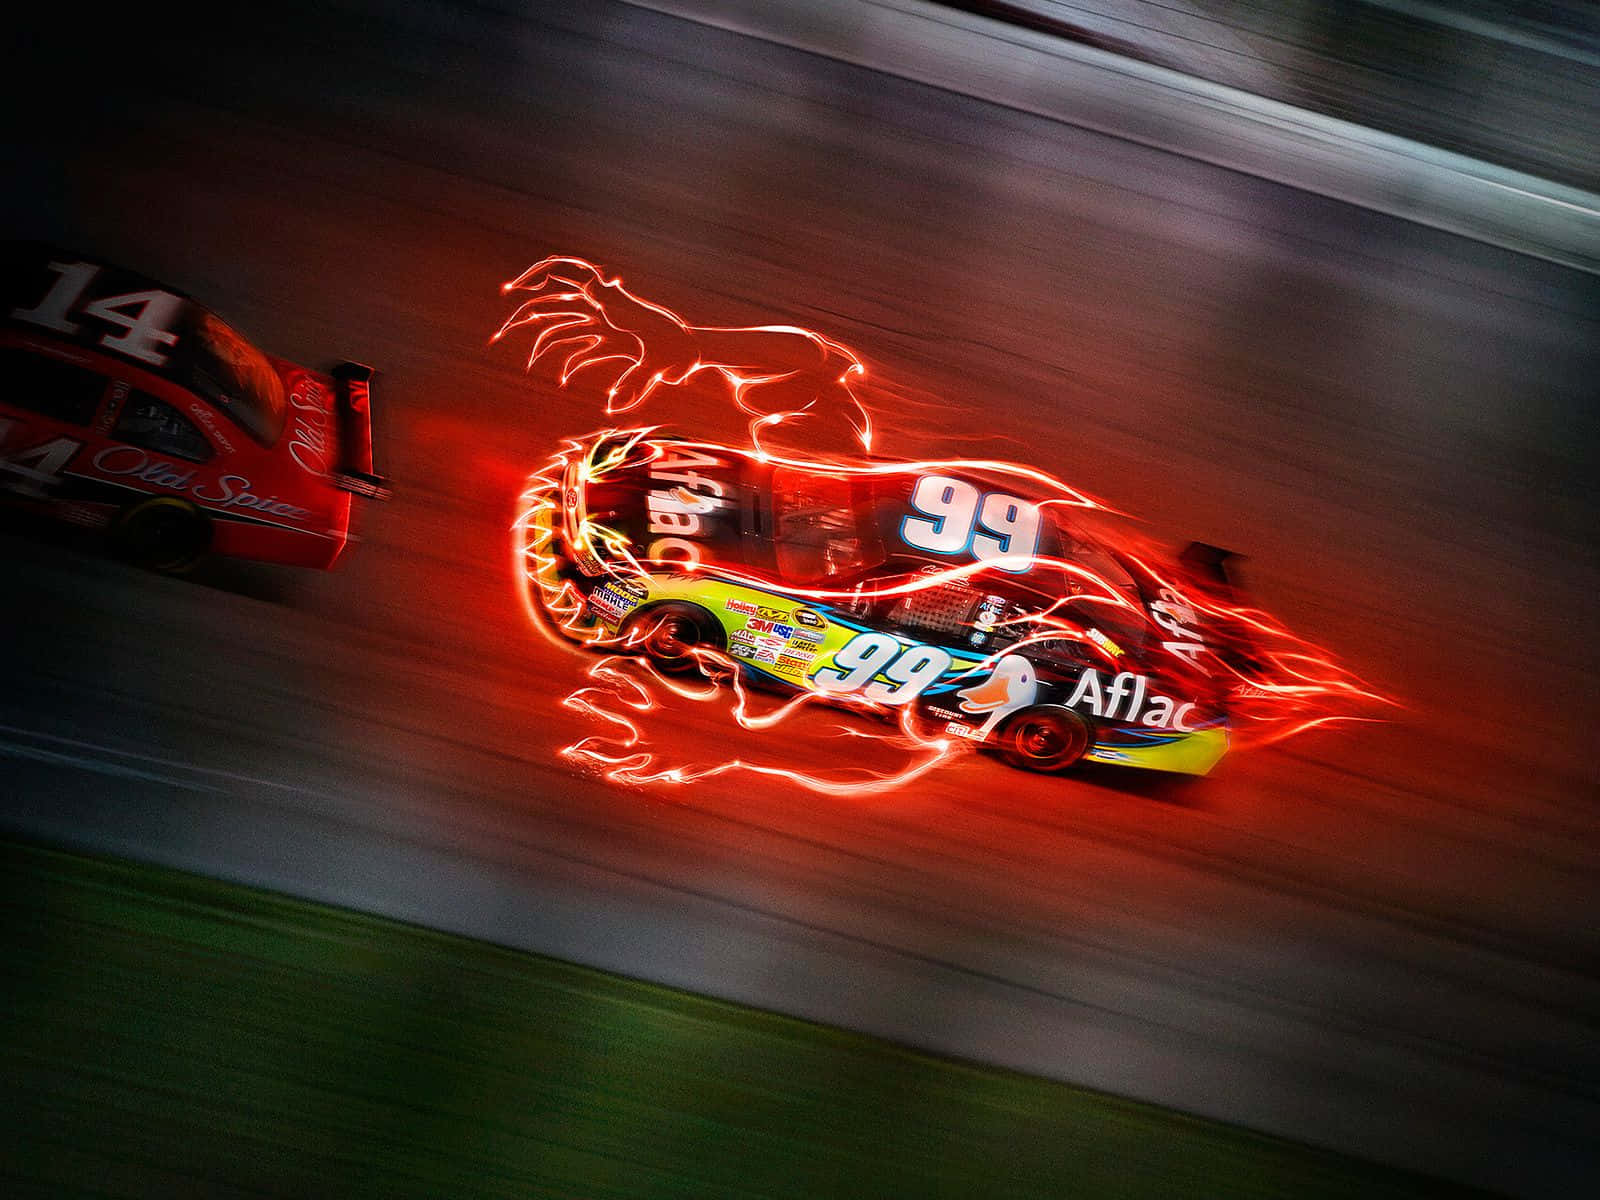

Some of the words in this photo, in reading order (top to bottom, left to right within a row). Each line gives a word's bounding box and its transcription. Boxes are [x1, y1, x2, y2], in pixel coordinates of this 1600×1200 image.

[10, 262, 182, 366] 14
[93, 446, 195, 491] Old
[192, 475, 312, 521] Spice
[901, 474, 1042, 575] 99
[593, 588, 628, 611] MAHLE
[604, 582, 639, 603] MOOG
[726, 600, 757, 616] Holley
[746, 618, 774, 634] 3M
[773, 623, 794, 640] USG
[1086, 628, 1125, 657] SUBWAY
[813, 632, 952, 705] 99
[1064, 667, 1197, 732] Aflac
